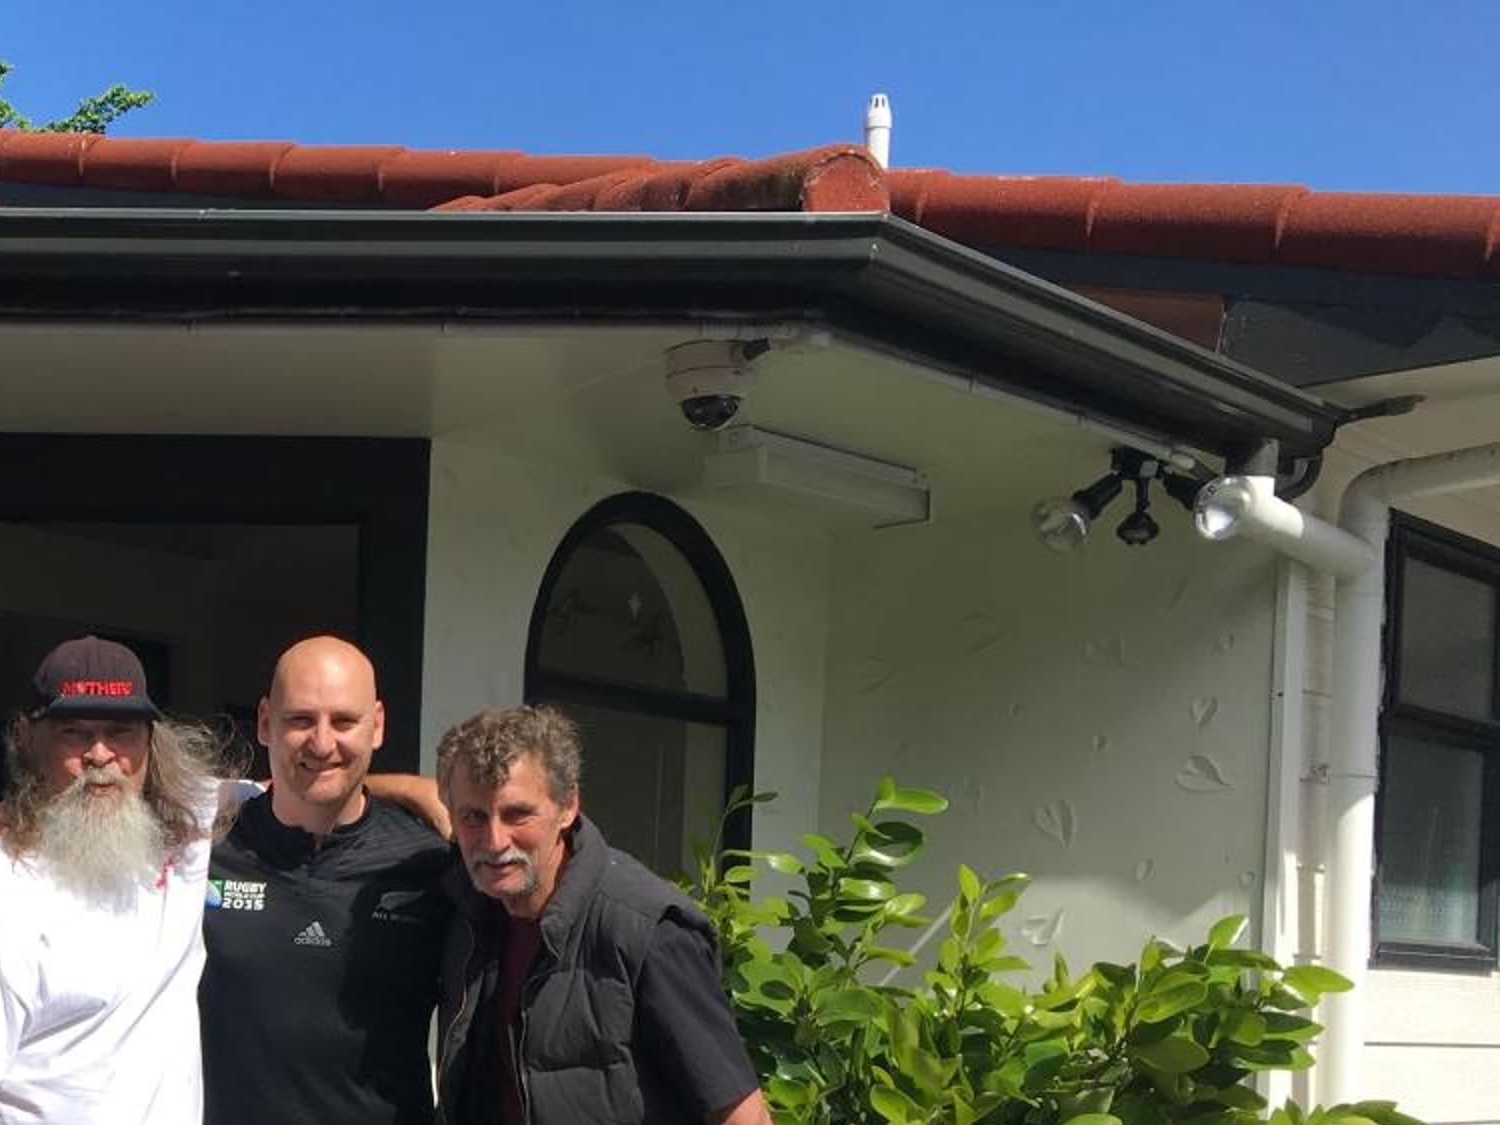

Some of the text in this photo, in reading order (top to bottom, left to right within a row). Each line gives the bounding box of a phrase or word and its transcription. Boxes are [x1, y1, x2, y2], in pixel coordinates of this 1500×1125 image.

[224, 881, 266, 893] RUGBY
[222, 898, 264, 910] 2015
[293, 936, 331, 946] adidas
